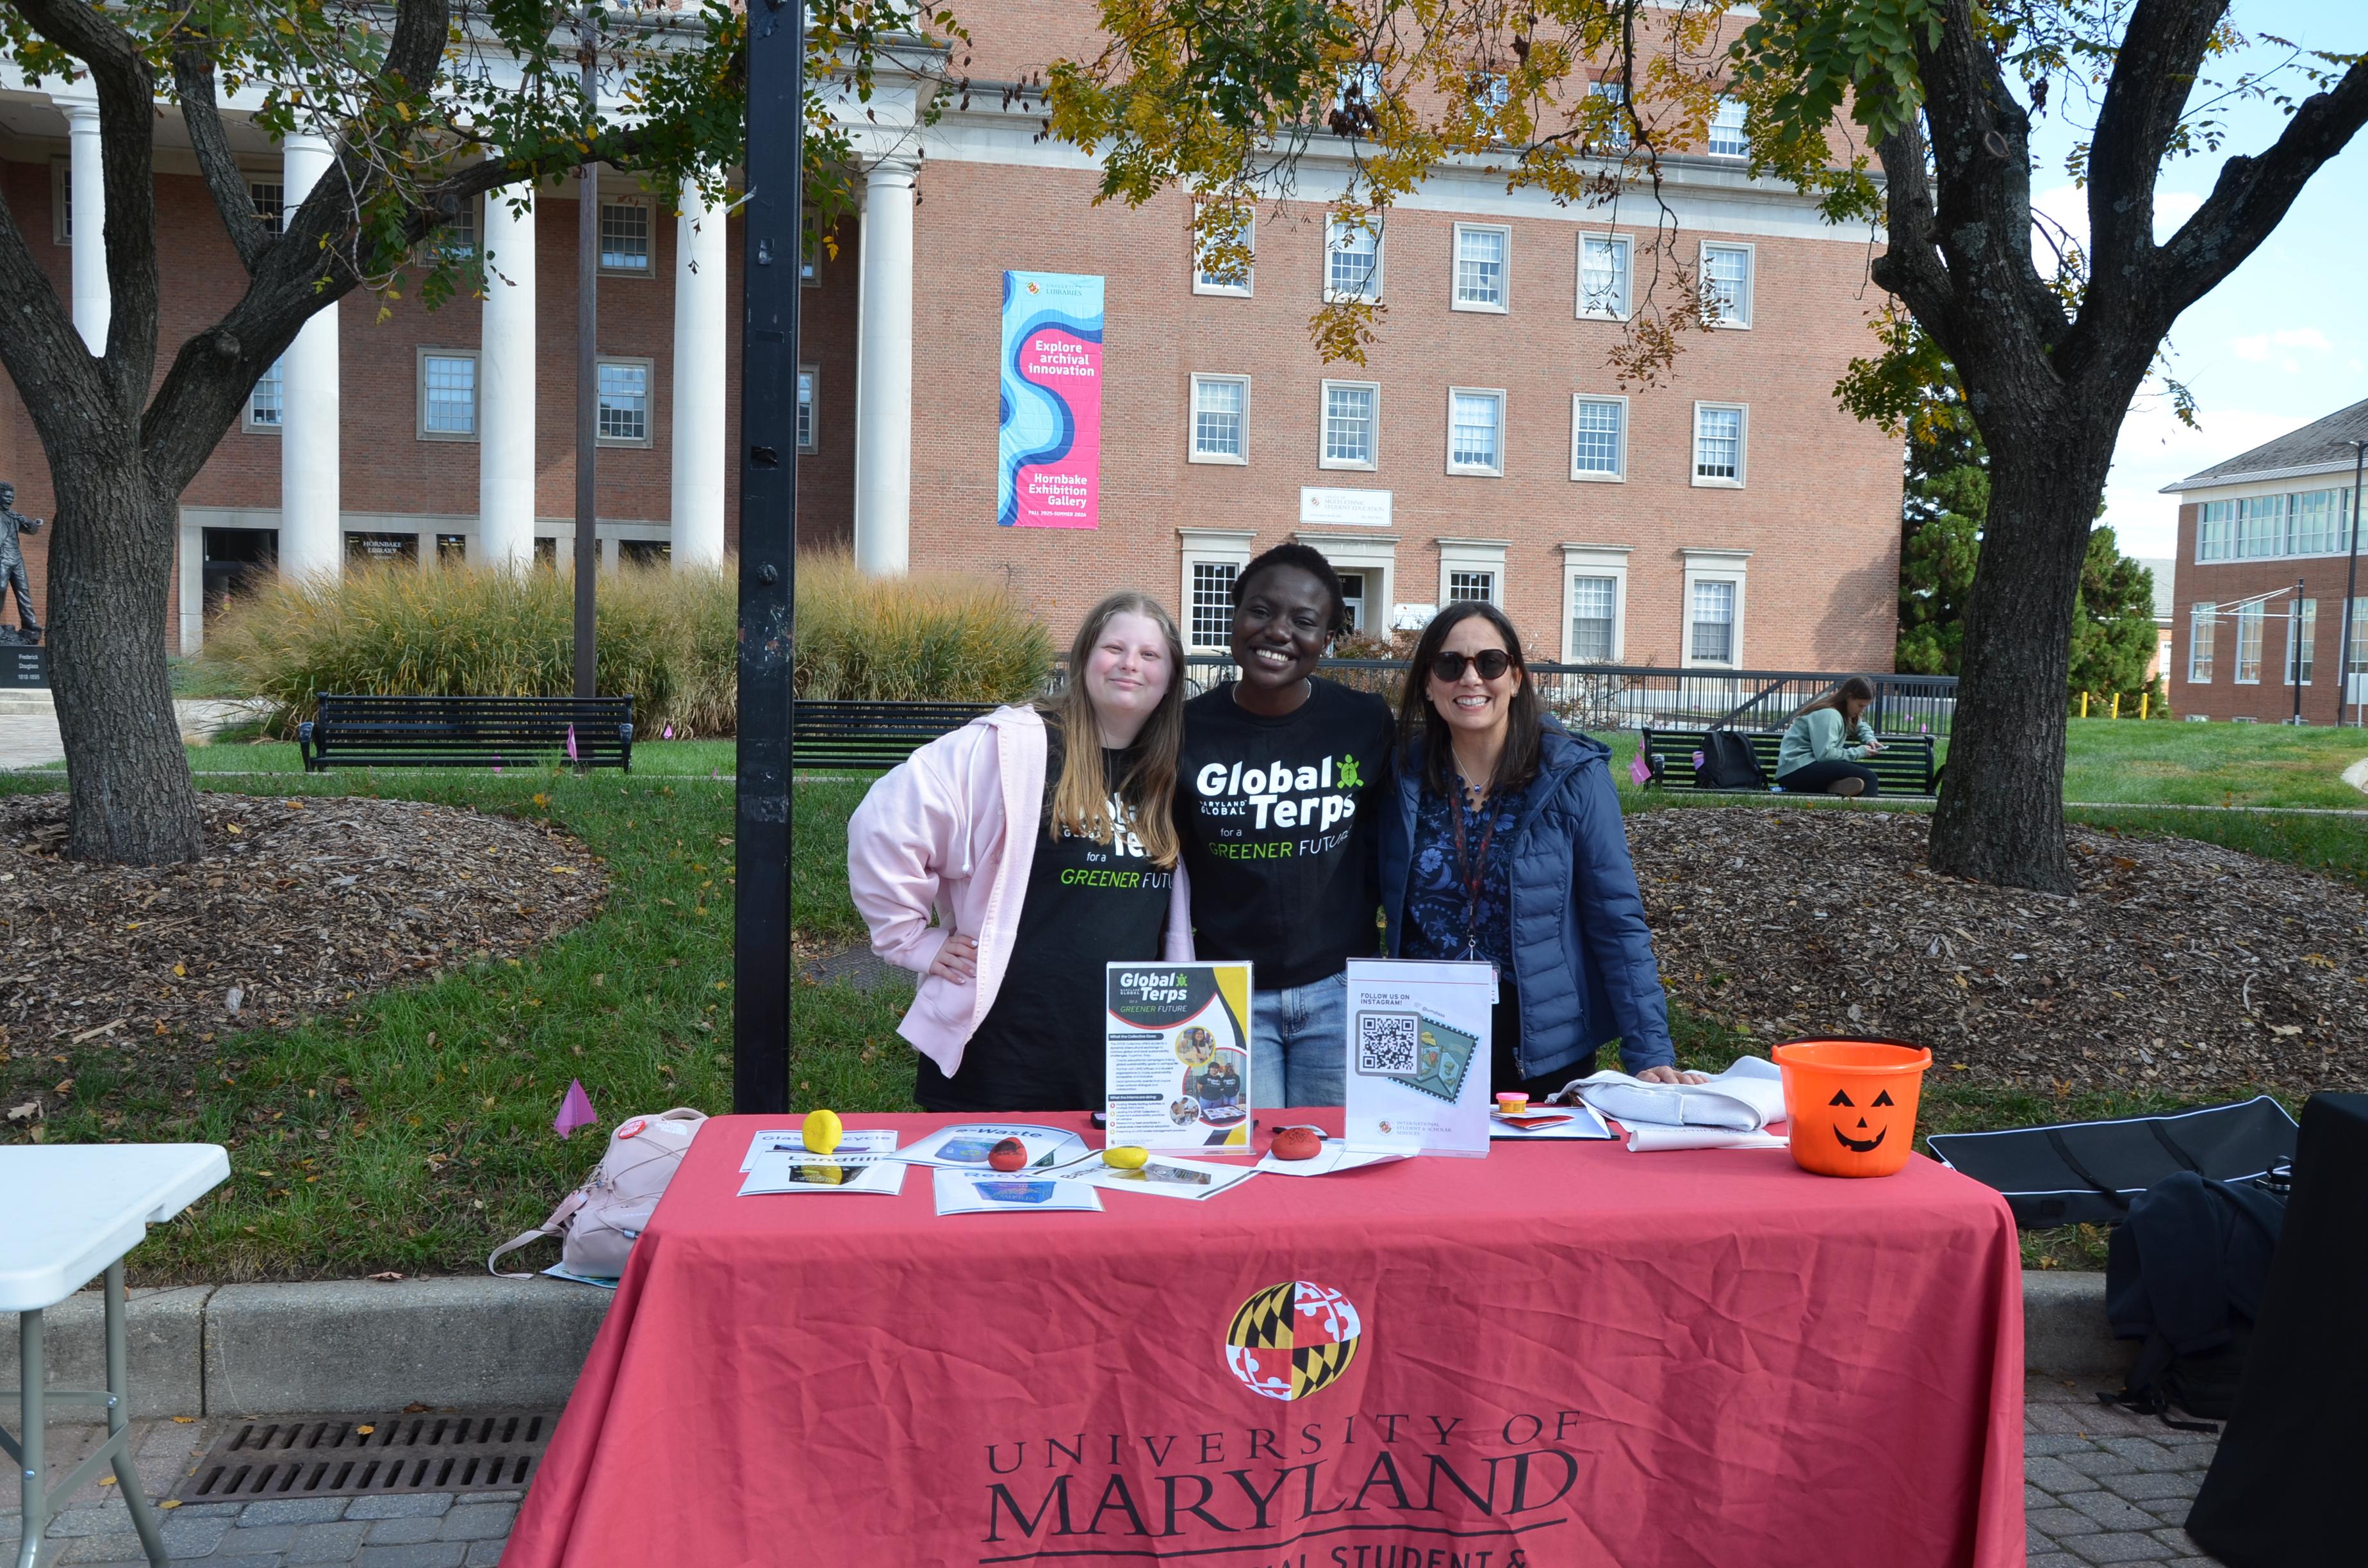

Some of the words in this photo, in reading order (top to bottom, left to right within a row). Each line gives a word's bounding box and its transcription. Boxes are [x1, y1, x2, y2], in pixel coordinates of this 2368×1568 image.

[1035, 340, 1082, 354] Explore
[1040, 352, 1089, 365] archival
[1028, 363, 1094, 377] innovation
[1034, 473, 1087, 485] Hornbake
[1029, 484, 1087, 496] Exhibition
[1048, 495, 1087, 509] Gallery
[1196, 755, 1332, 796] Global
[1201, 806, 1246, 815] GLOBAL
[1249, 793, 1356, 832] Terps
[1221, 828, 1234, 837] for
[1087, 852, 1099, 862] for
[1101, 854, 1106, 862] a
[1209, 842, 1293, 859] GREENER
[1061, 869, 1140, 888] GREENER
[1120, 972, 1176, 987] Global
[1140, 987, 1187, 1004] Terps
[955, 1128, 1042, 1138] e-Waste
[984, 1414, 1464, 1474] UNIVERSITY
[1502, 1410, 1581, 1446] OF
[980, 1448, 1579, 1543] MARYLAND
[1331, 1545, 1493, 1568] STUDENT
